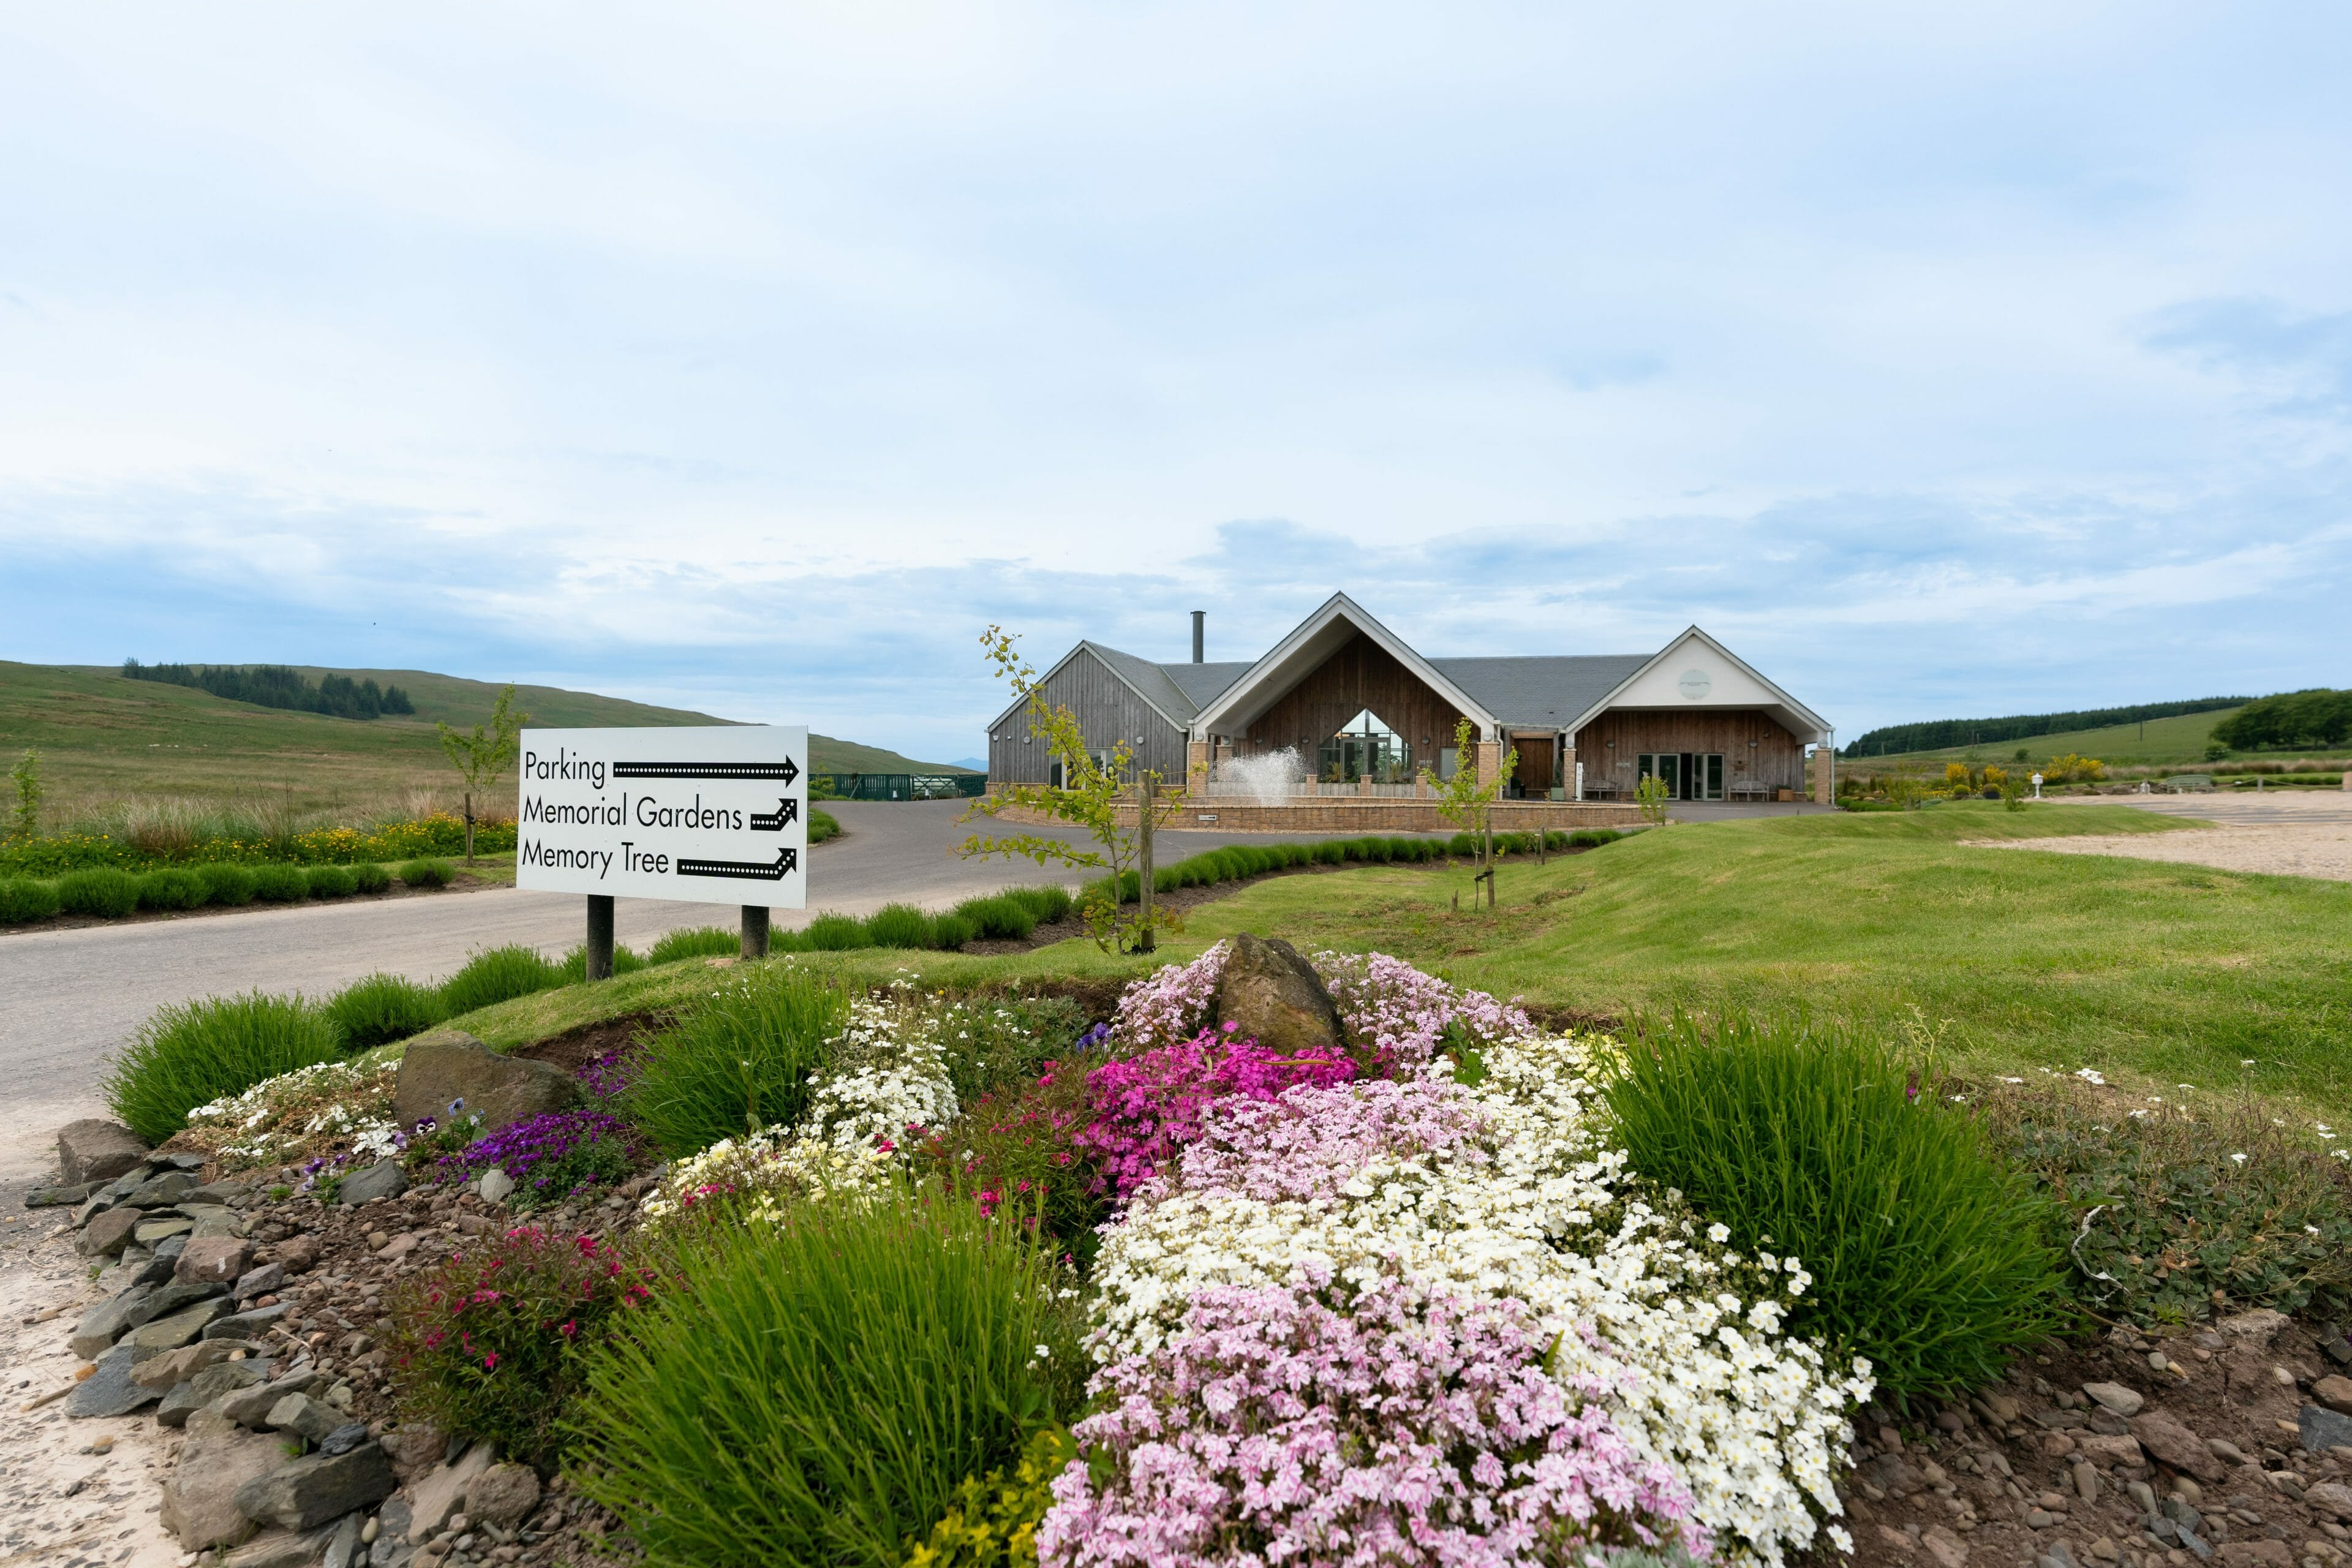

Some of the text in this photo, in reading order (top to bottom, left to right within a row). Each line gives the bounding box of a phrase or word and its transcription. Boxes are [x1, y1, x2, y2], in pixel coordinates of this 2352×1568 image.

[526, 747, 605, 790] Parking
[523, 792, 742, 830] Memorial Gardens
[522, 838, 669, 880] Memory Tree
